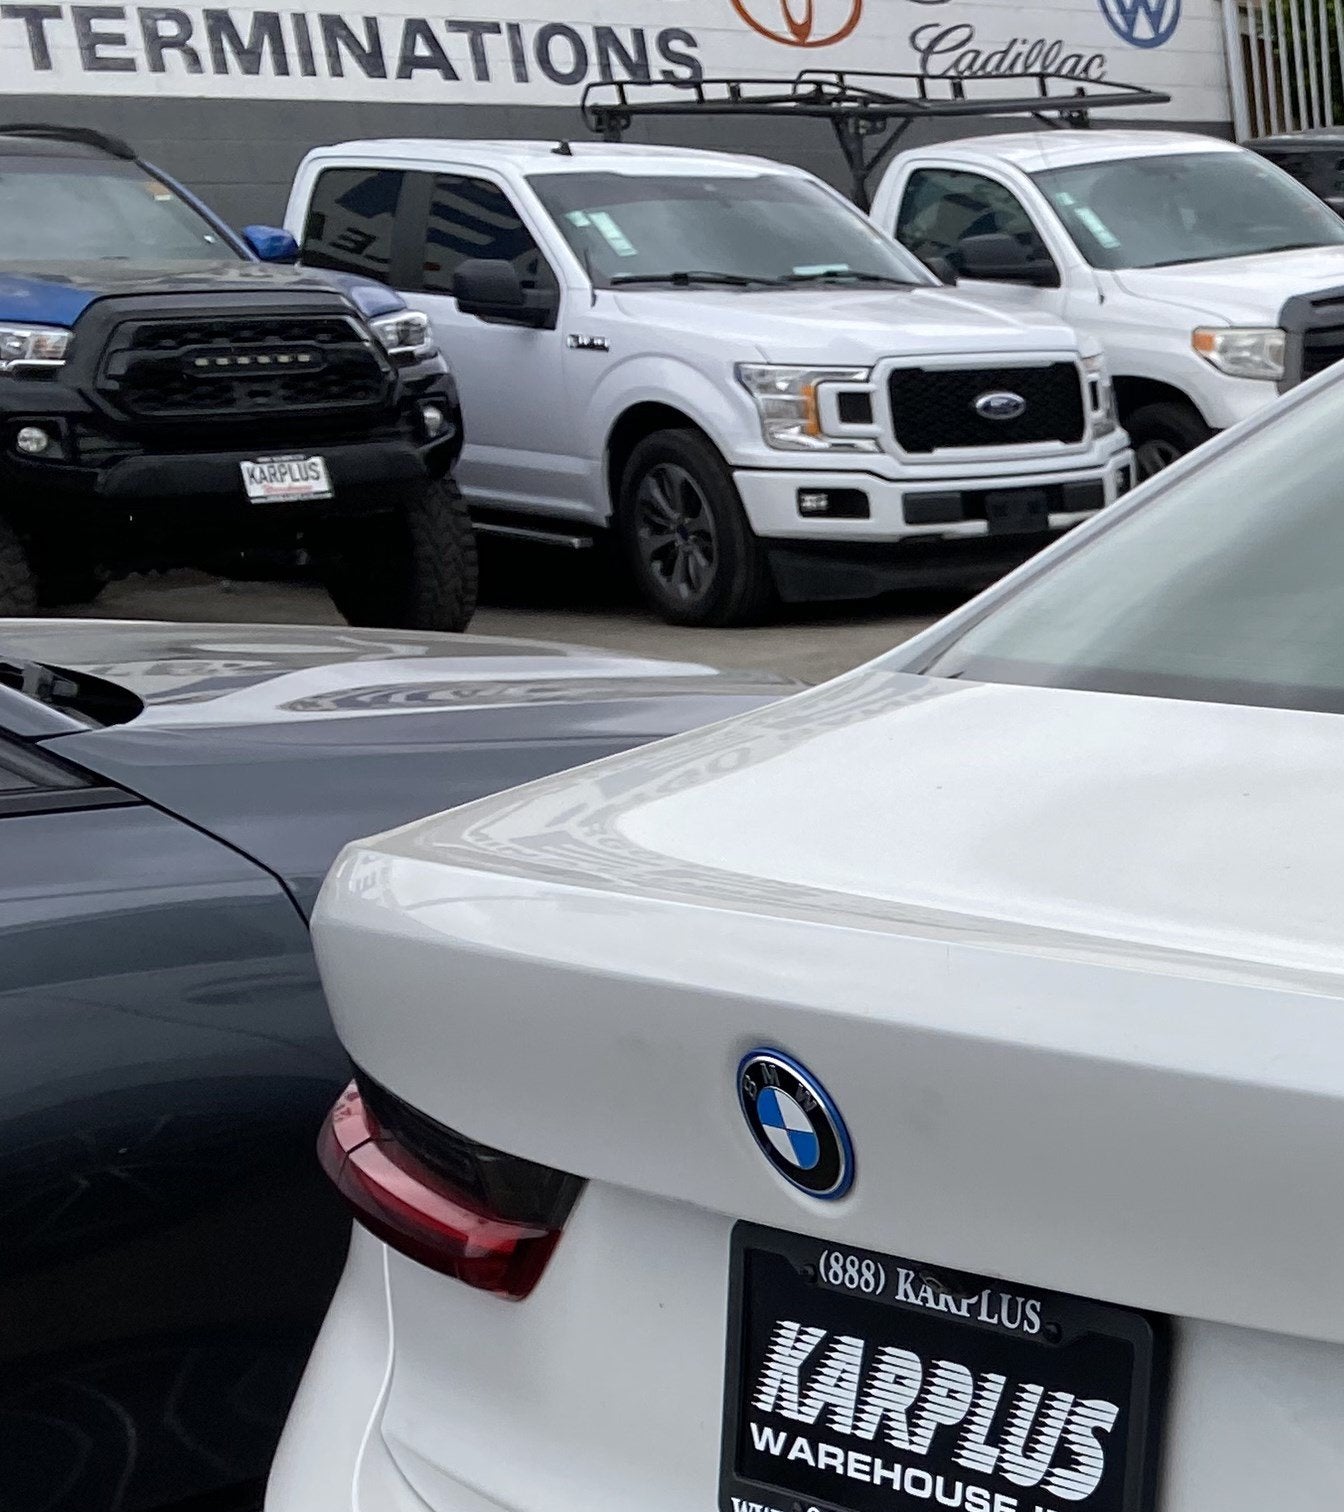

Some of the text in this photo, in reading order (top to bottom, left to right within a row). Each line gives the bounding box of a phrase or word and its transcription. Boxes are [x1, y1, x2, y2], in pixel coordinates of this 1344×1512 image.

[2, 4, 702, 90] TERMINATIONS
[910, 23, 1107, 81] Cadillac
[246, 462, 320, 485] KARPLUS
[744, 1062, 818, 1112] BMW
[818, 1249, 886, 1296] (888)
[750, 1319, 1119, 1501] KARPLUS
